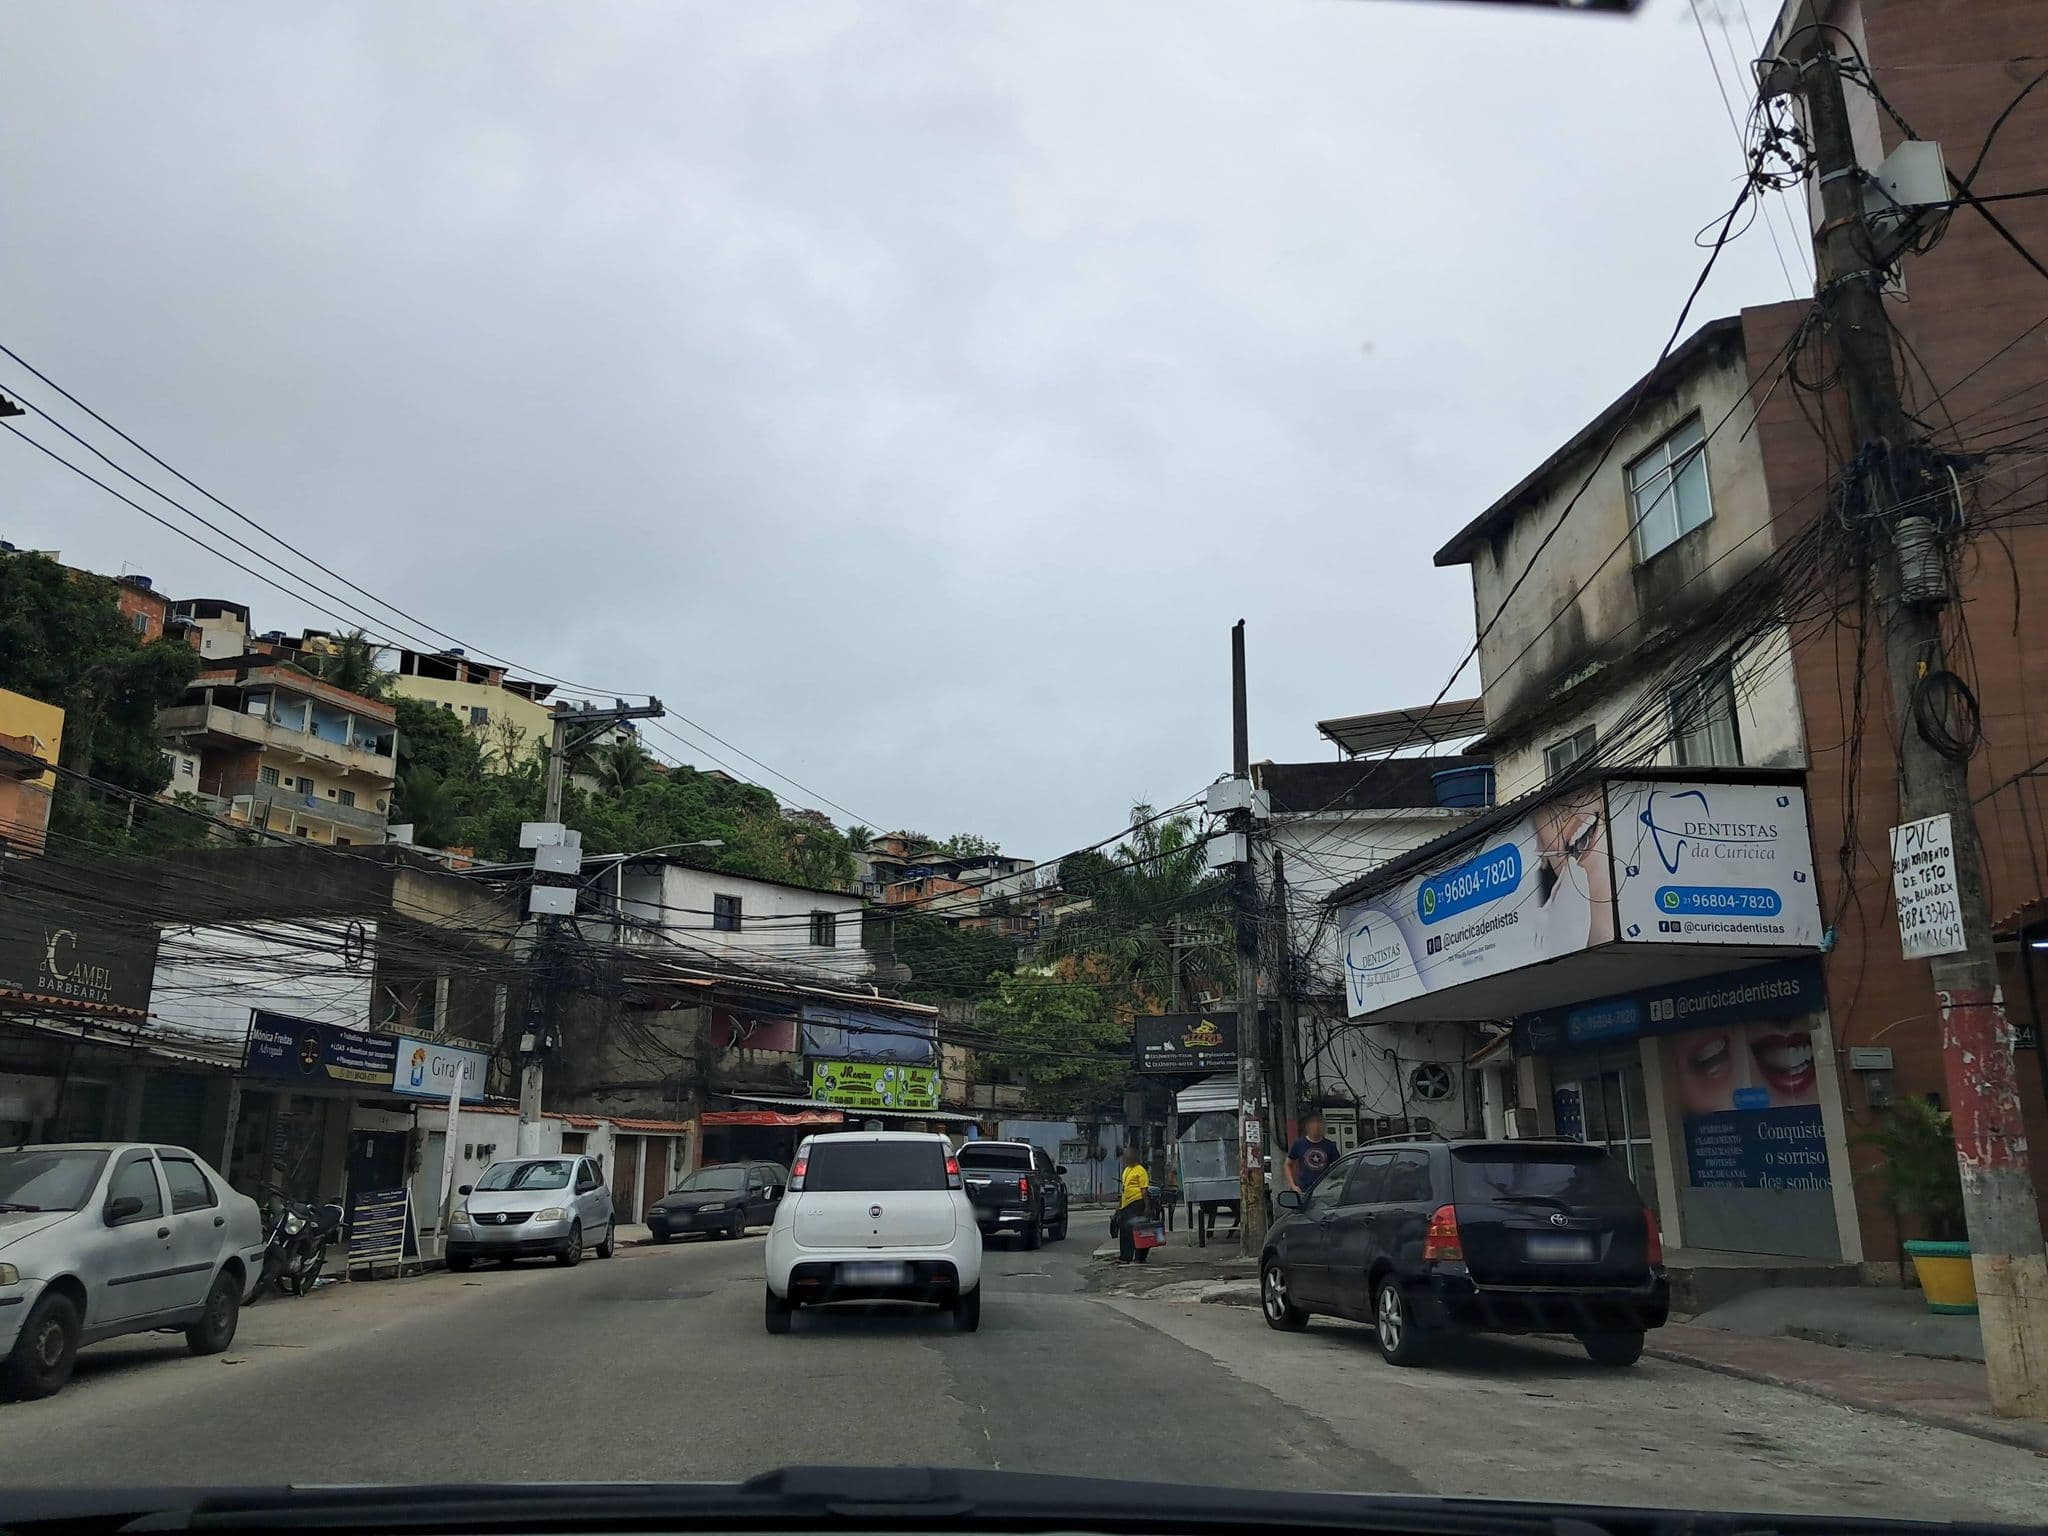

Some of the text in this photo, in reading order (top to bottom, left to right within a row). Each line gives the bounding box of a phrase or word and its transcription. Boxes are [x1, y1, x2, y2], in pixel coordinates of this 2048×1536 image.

[1684, 822, 1778, 838] DENTISTAS
[1905, 821, 1938, 852] PVC
[1691, 842, 1776, 860] da Curicica
[1445, 856, 1516, 904] 96804-7820
[1902, 865, 1946, 888] DE TETO
[1692, 894, 1775, 909] 96804-7820
[1915, 883, 1954, 902] BLINDEX
[1442, 911, 1519, 950] @curicicadentistas
[1684, 921, 1785, 934] @curicicadentistas
[46, 929, 112, 991] CAMEL
[1361, 943, 1401, 969] DENTISTAS
[38, 976, 109, 1002] BARBEARIA
[1676, 977, 1801, 1018] @curicicadentistas
[1757, 1121, 1825, 1144] Conquiste
[1765, 1147, 1825, 1165] o sorriso
[1759, 1171, 1782, 1190] dos
[1786, 1172, 1833, 1190] sonhos
